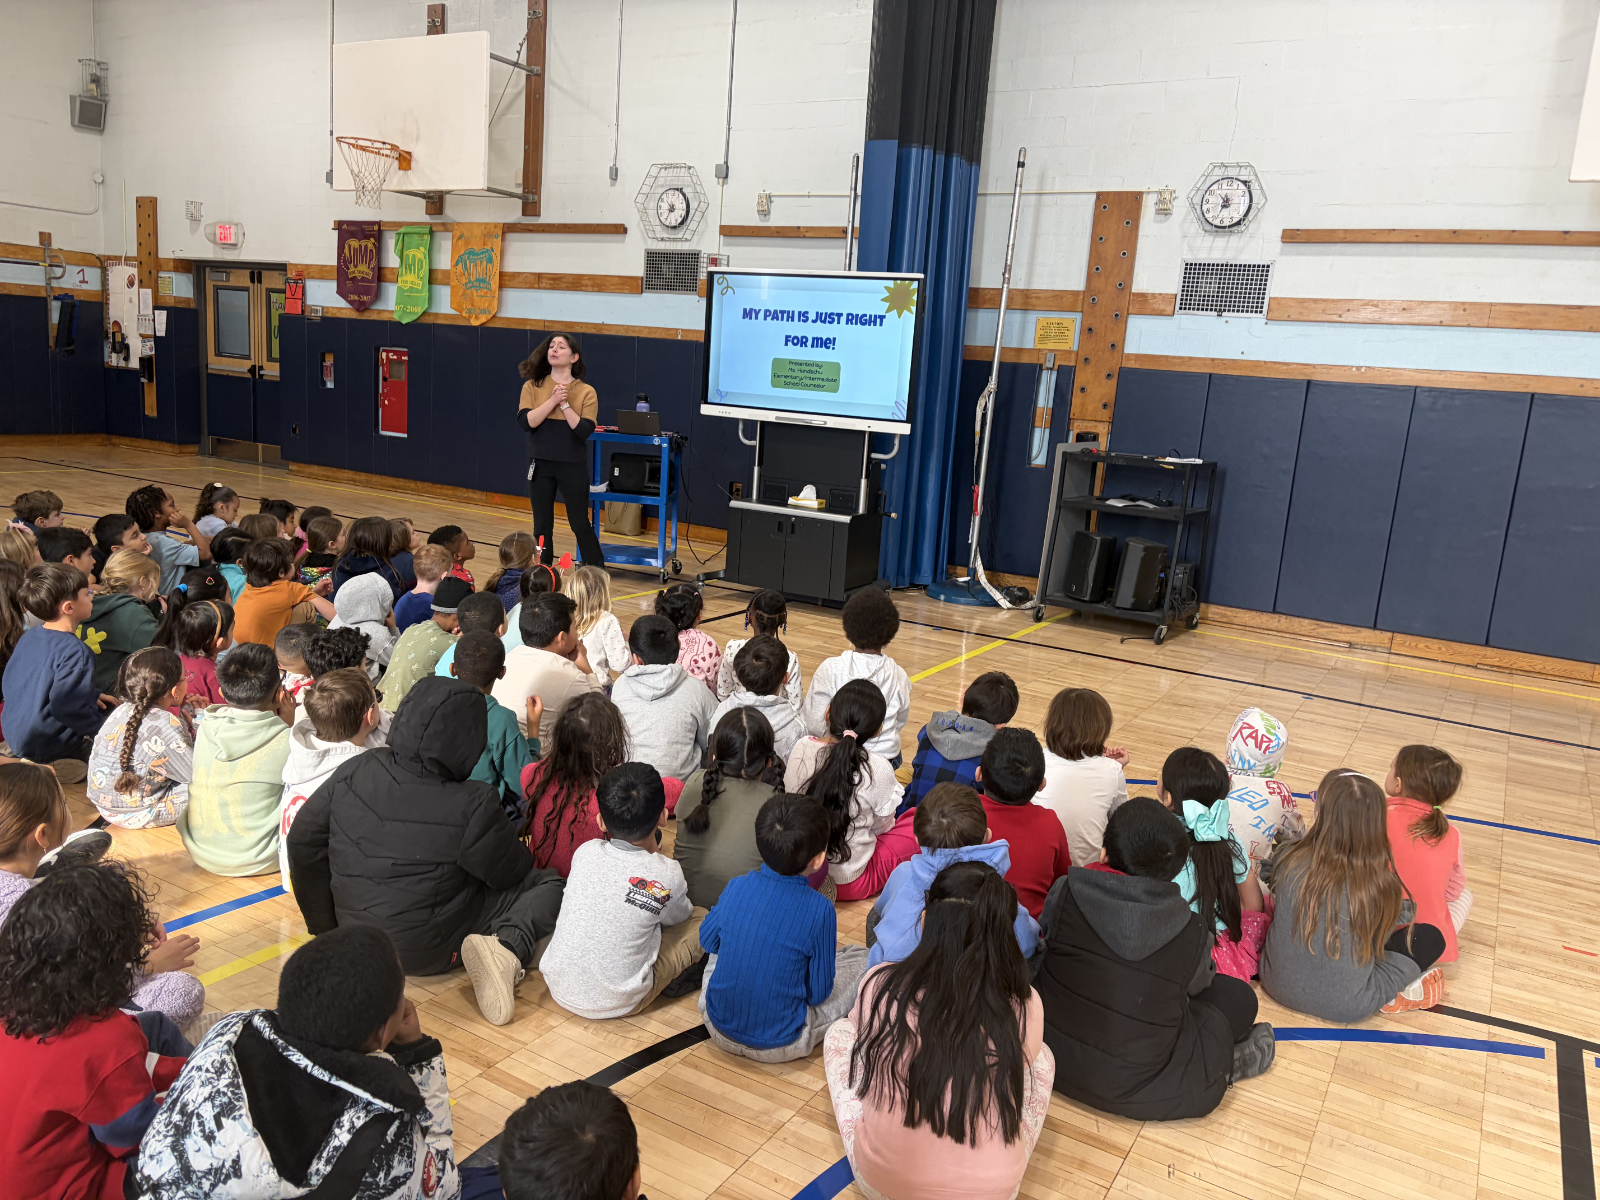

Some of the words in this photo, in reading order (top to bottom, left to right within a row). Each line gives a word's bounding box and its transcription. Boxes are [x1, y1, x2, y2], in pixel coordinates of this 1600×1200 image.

[219, 225, 232, 242] EXIT
[346, 242, 374, 270] JUMP
[76, 268, 88, 284] 1
[465, 260, 493, 282] JUMP
[348, 294, 370, 302] 2006-2007
[742, 308, 761, 320] MY
[764, 309, 795, 323] PATH
[798, 311, 809, 323] IS
[811, 312, 843, 325] JUST
[845, 313, 886, 327] RIGHT
[784, 335, 808, 348] FOR
[810, 337, 836, 350] me!
[774, 373, 838, 383] Elementary/Intermediate
[624, 897, 661, 916] McQUEEN
[629, 892, 664, 910] LIGHTNING
